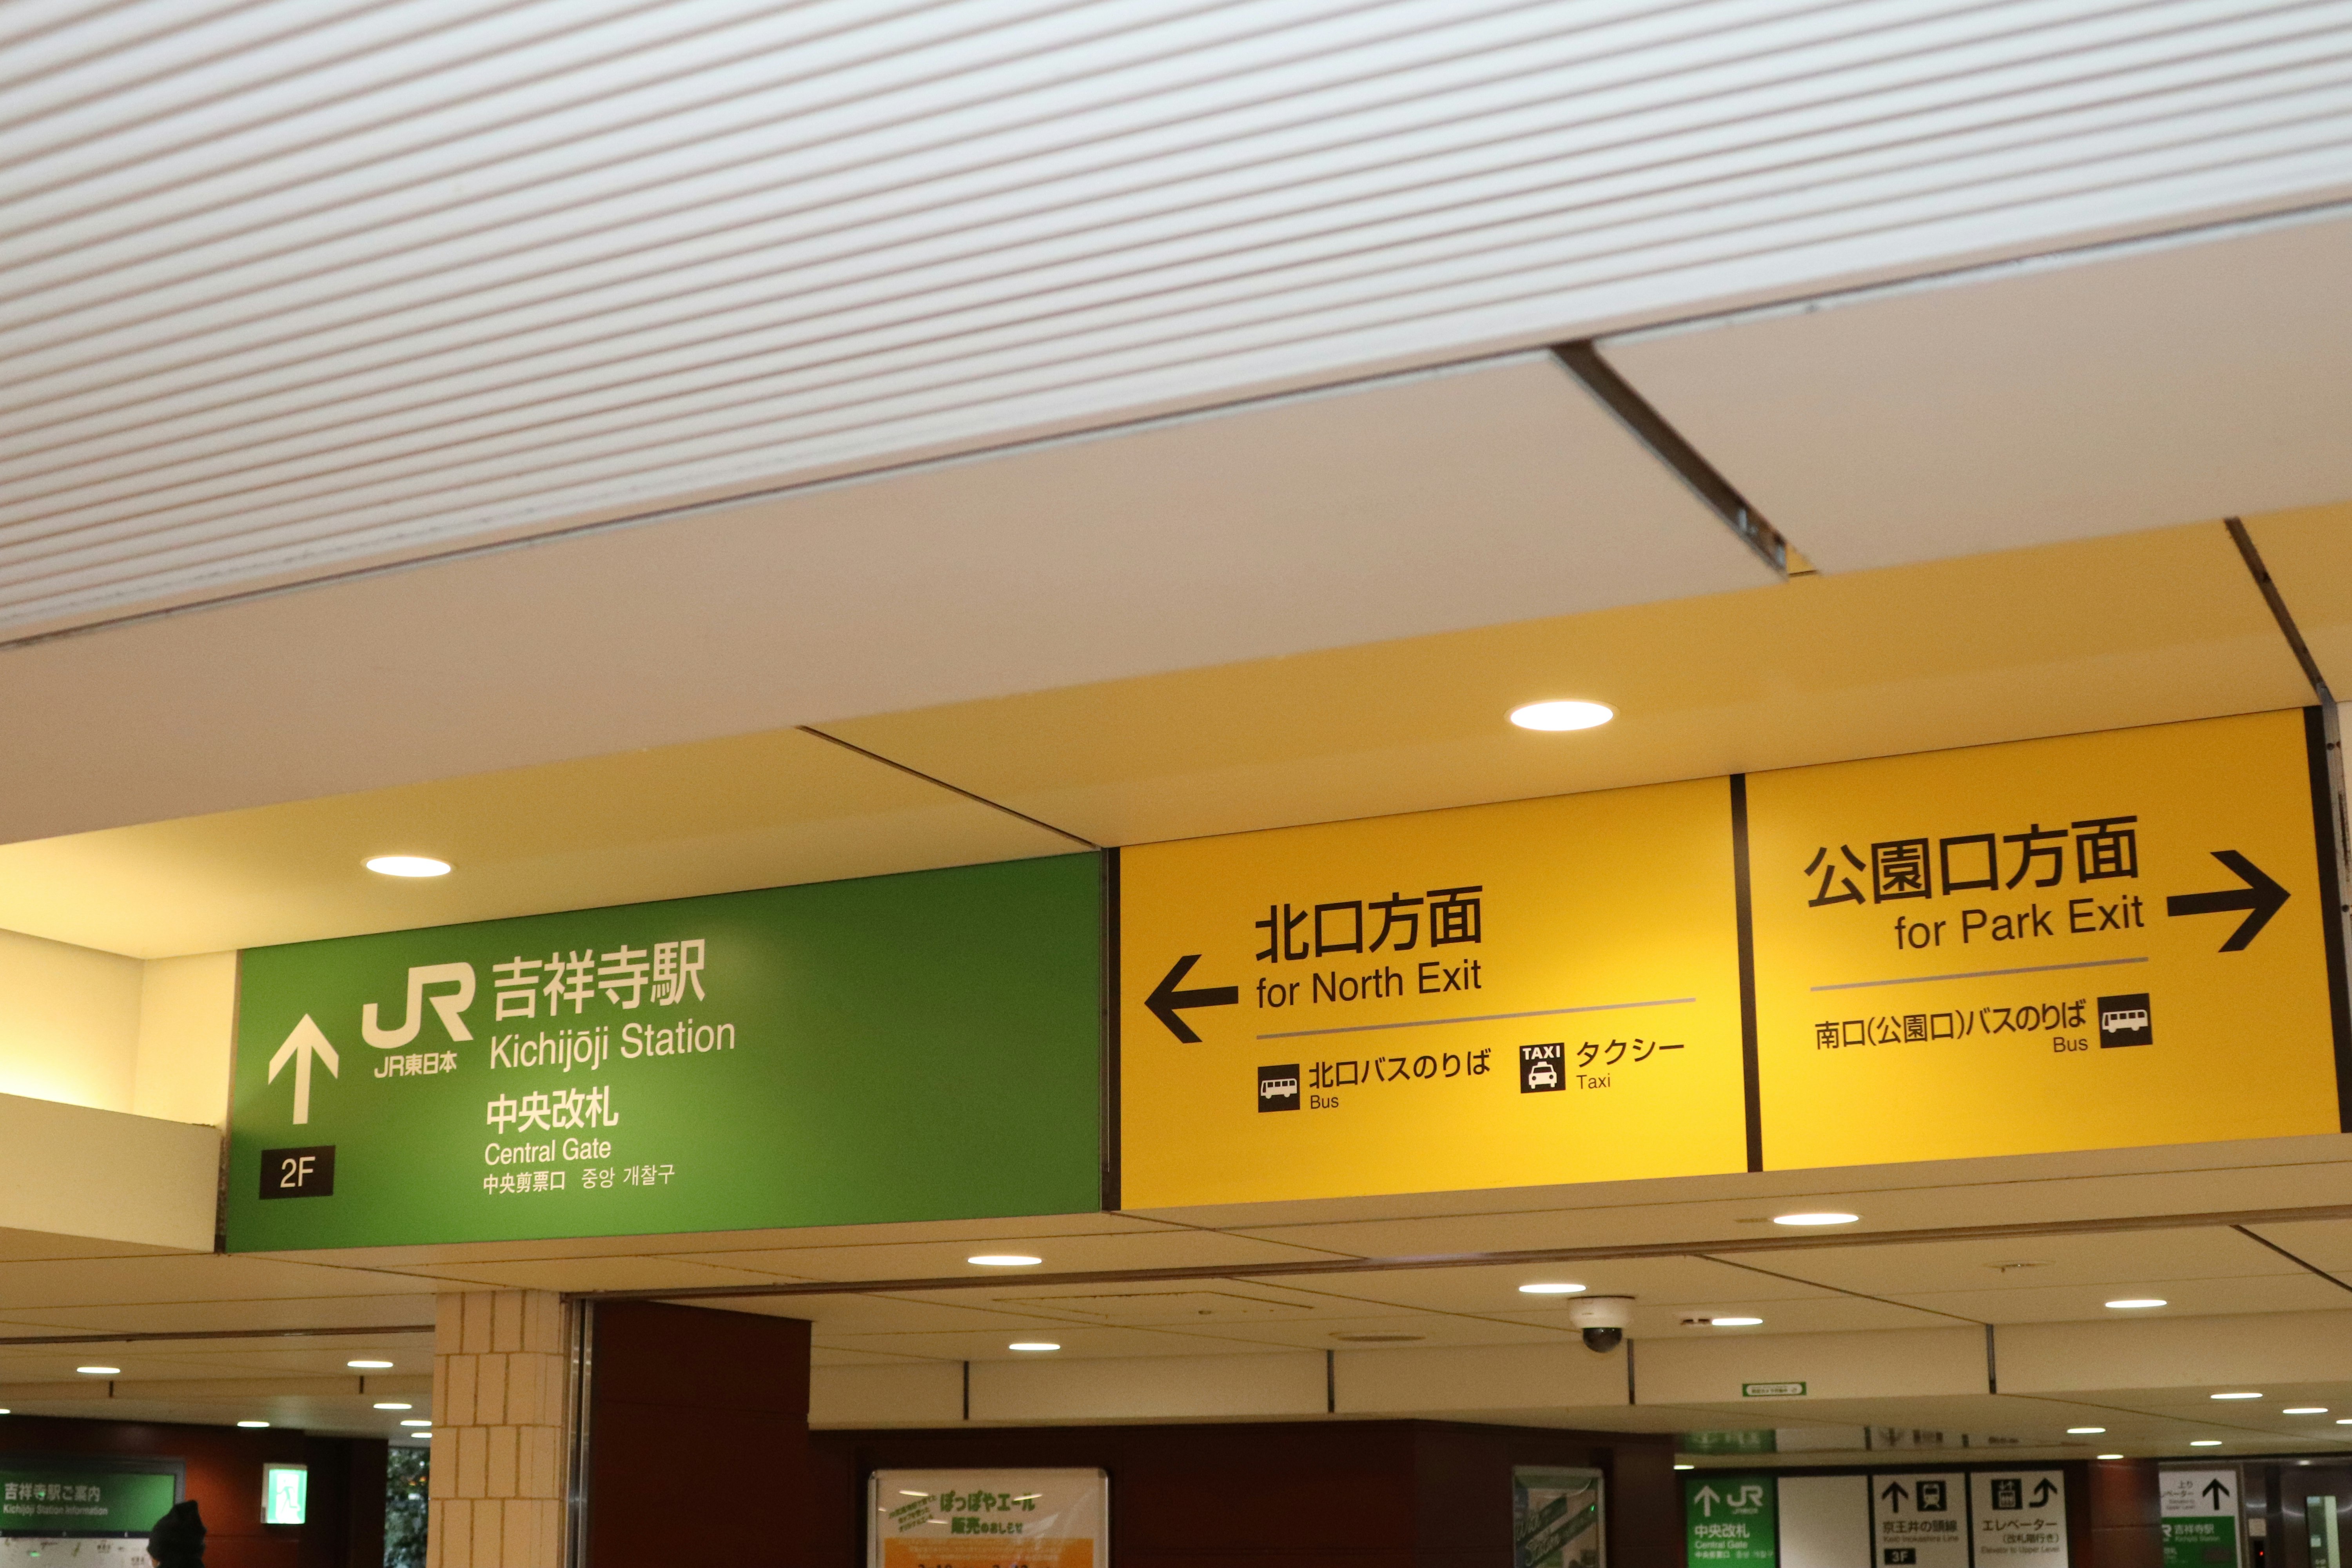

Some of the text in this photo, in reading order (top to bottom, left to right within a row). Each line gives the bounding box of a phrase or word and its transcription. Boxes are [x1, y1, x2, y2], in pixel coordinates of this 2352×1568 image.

[1802, 815, 2138, 908] 公園口方面
[1256, 886, 1482, 964] 北口方面
[1895, 895, 2144, 949] for Park Exit
[493, 939, 705, 1022] 吉祥寺駅
[1257, 959, 1481, 1008] for North Exit
[362, 962, 475, 1049] JR
[1815, 998, 2088, 1049] 南口(公園口)バスのりば
[491, 1021, 734, 1073] Kichijōji Station
[1523, 1046, 1561, 1060] TAXI
[1577, 1039, 1684, 1067] タクシー
[2053, 1037, 2088, 1053] Bus
[374, 1050, 457, 1078] JR東日本
[1309, 1048, 1491, 1089] 北口バスのりば
[1576, 1074, 1610, 1089] Taxi
[487, 1085, 619, 1134] 中央改札
[1310, 1095, 1339, 1109] Bus
[485, 1138, 611, 1165] Central Gate
[281, 1156, 315, 1187] 2F
[484, 1171, 565, 1194] 中央剪票口
[582, 1165, 675, 1189] 중앙 개찰구
[5, 1483, 100, 1502] 吉祥寺駅ご案内
[1727, 1485, 1763, 1507] JR
[1695, 1523, 1750, 1538] 中央改札
[1883, 1520, 1957, 1533] 京王井の頭線
[1983, 1519, 2057, 1531] エレベーター
[1892, 1551, 1908, 1562] 3F
